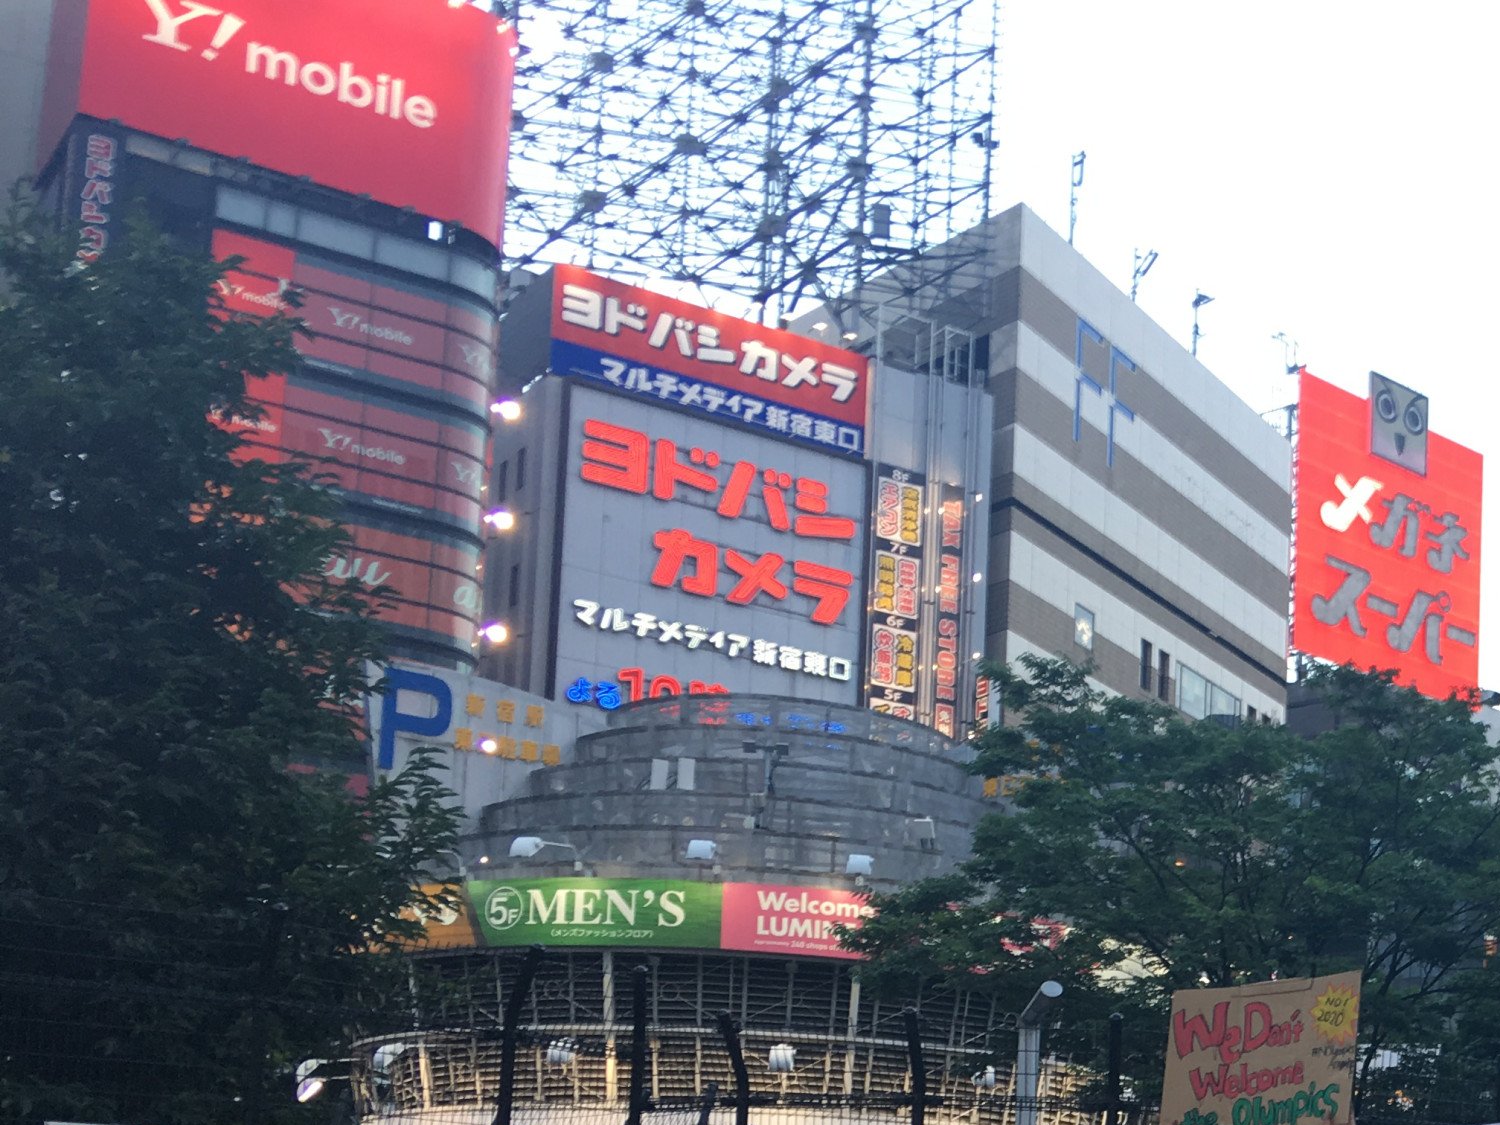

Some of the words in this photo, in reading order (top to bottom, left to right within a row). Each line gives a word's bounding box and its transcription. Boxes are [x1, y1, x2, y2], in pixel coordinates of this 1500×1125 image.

[245, 41, 438, 128] mobile
[359, 323, 414, 346] mobile
[561, 284, 858, 403] ヨドバシカメラ
[351, 443, 407, 466] mobile
[580, 419, 857, 540] ヨドバシ
[1320, 473, 1470, 575] メガネ
[651, 528, 854, 625] カメラ
[1311, 554, 1477, 666] スーパー
[573, 599, 852, 681] マルチメディア新宿東口
[886, 615, 905, 628] 6F
[936, 618, 958, 701] STORE
[378, 667, 453, 771] P
[1173, 1001, 1244, 1065] We
[1189, 1061, 1304, 1102] Welcome
